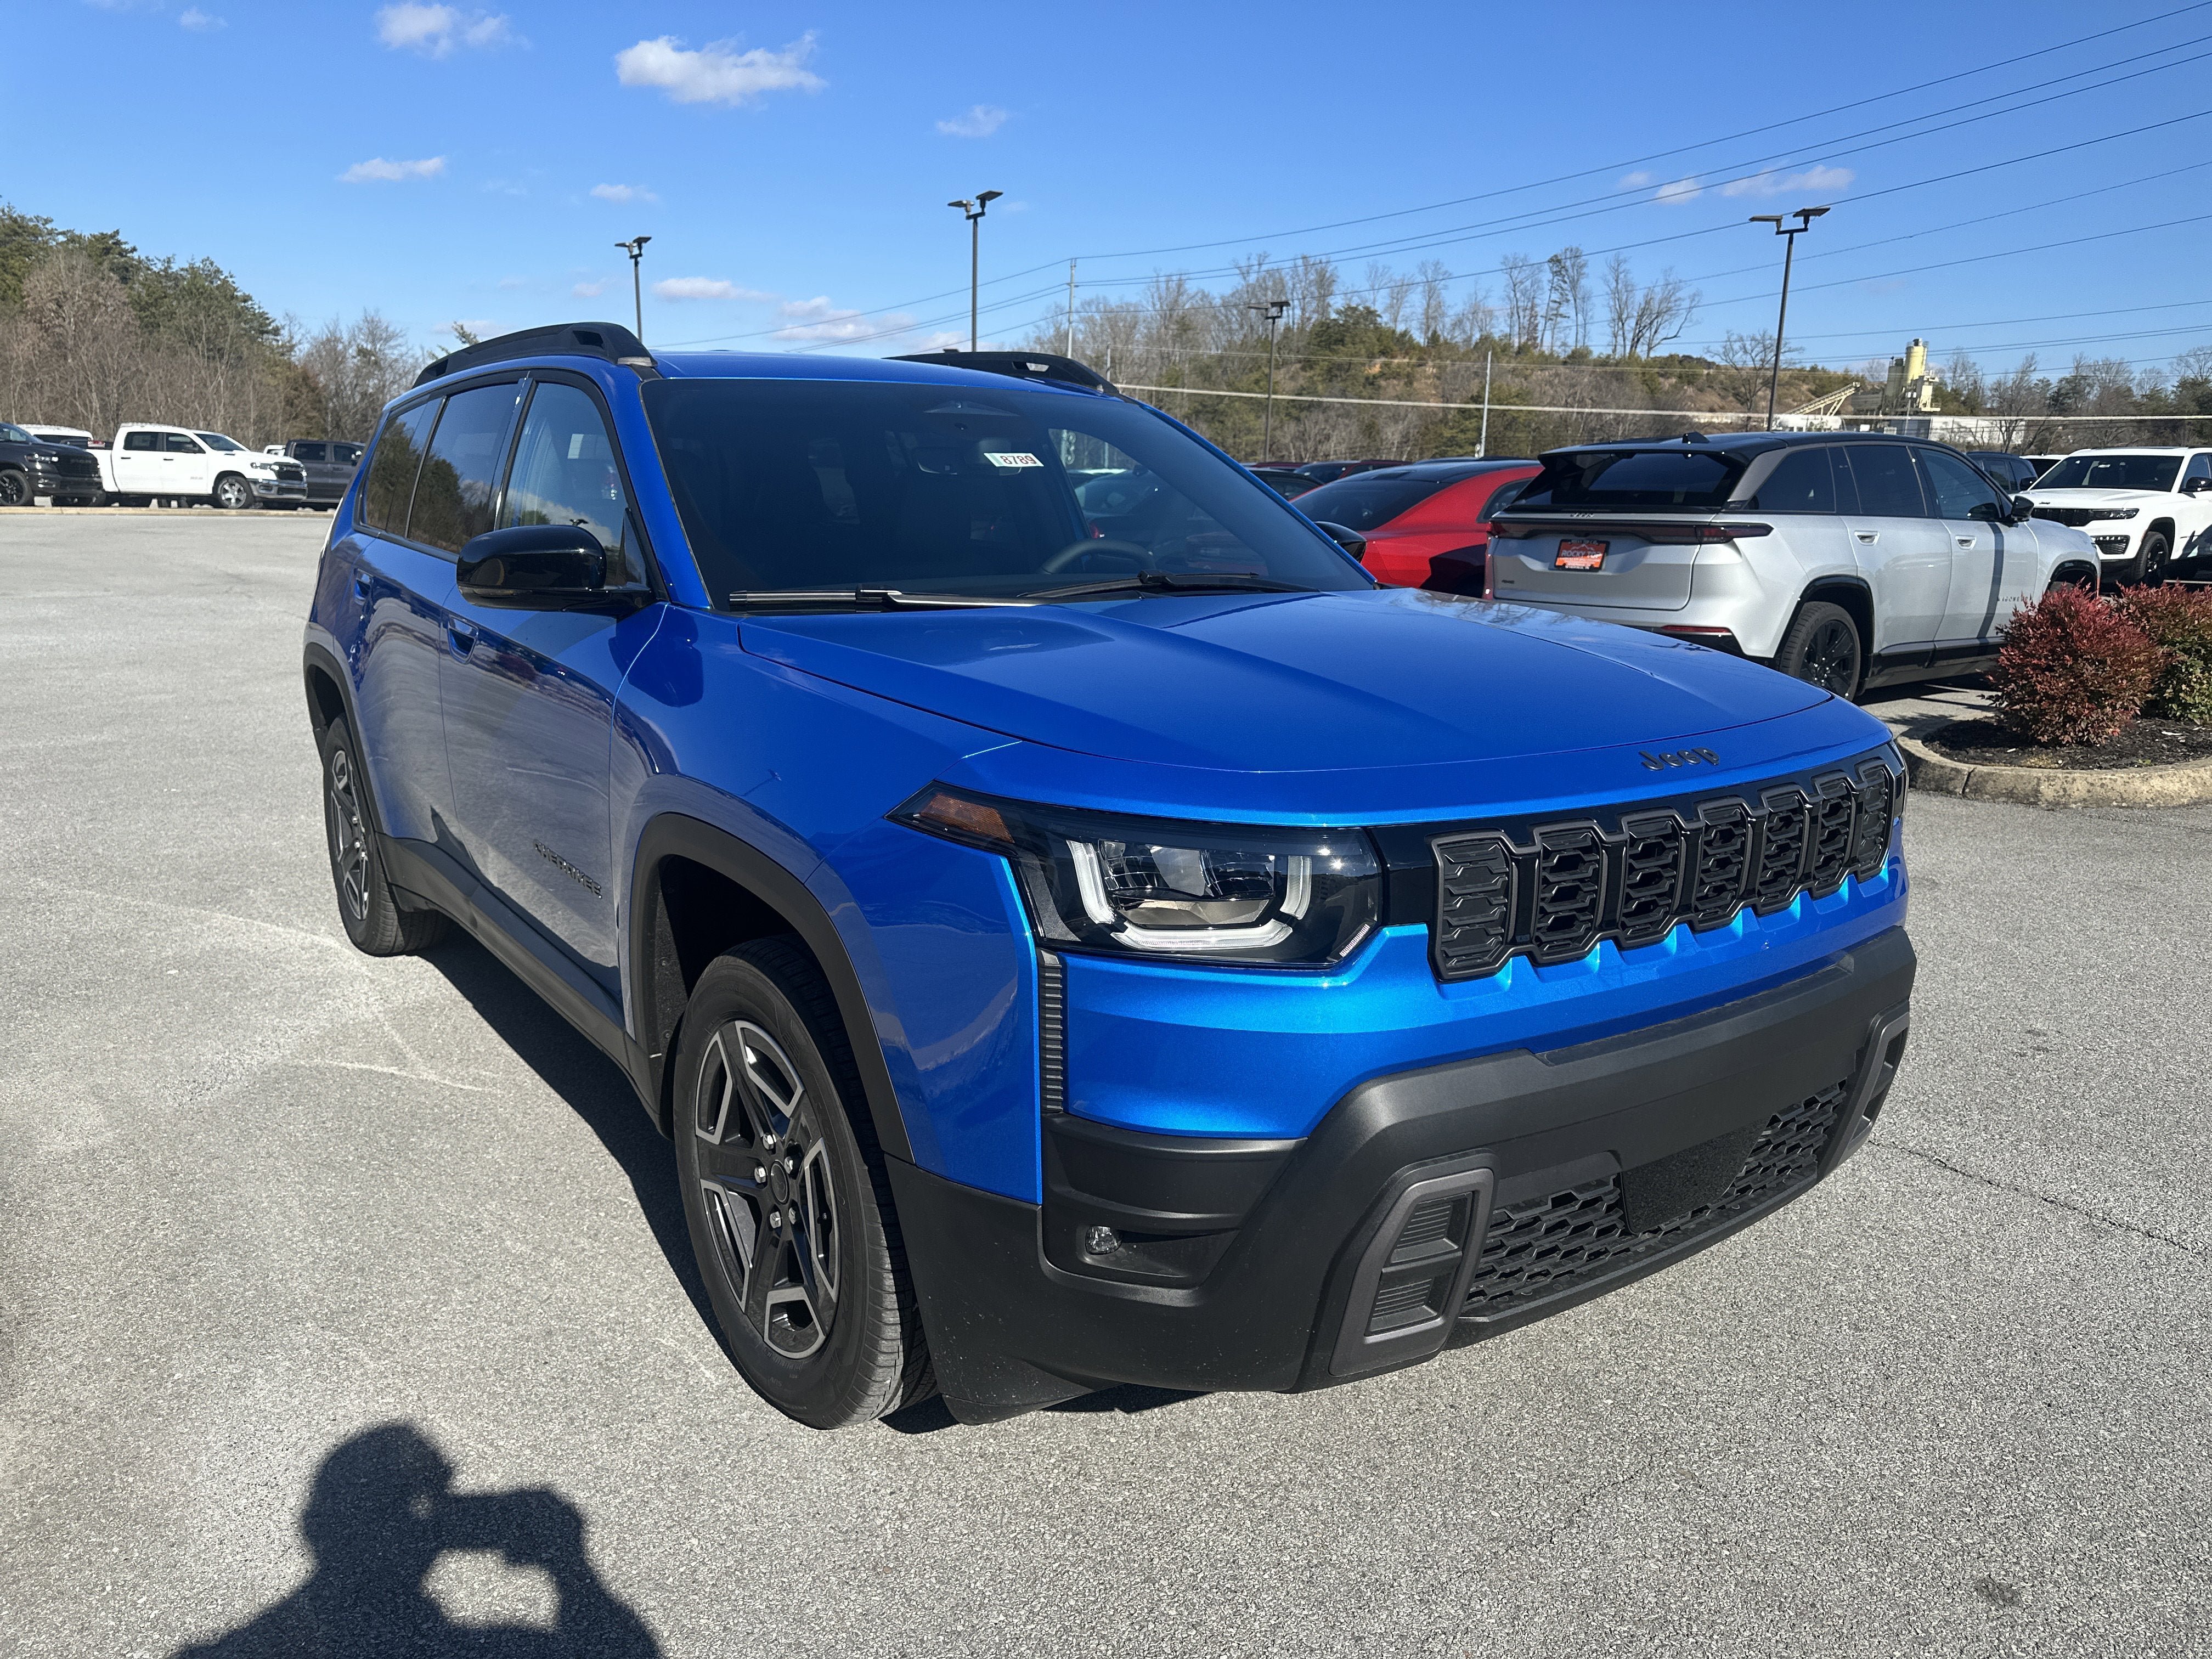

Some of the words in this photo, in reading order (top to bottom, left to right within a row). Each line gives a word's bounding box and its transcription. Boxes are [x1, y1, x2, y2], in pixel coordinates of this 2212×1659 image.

[1000, 455, 1037, 465] 8789
[1638, 746, 1720, 771] Jeep
[532, 838, 603, 900] CHEROKEE
